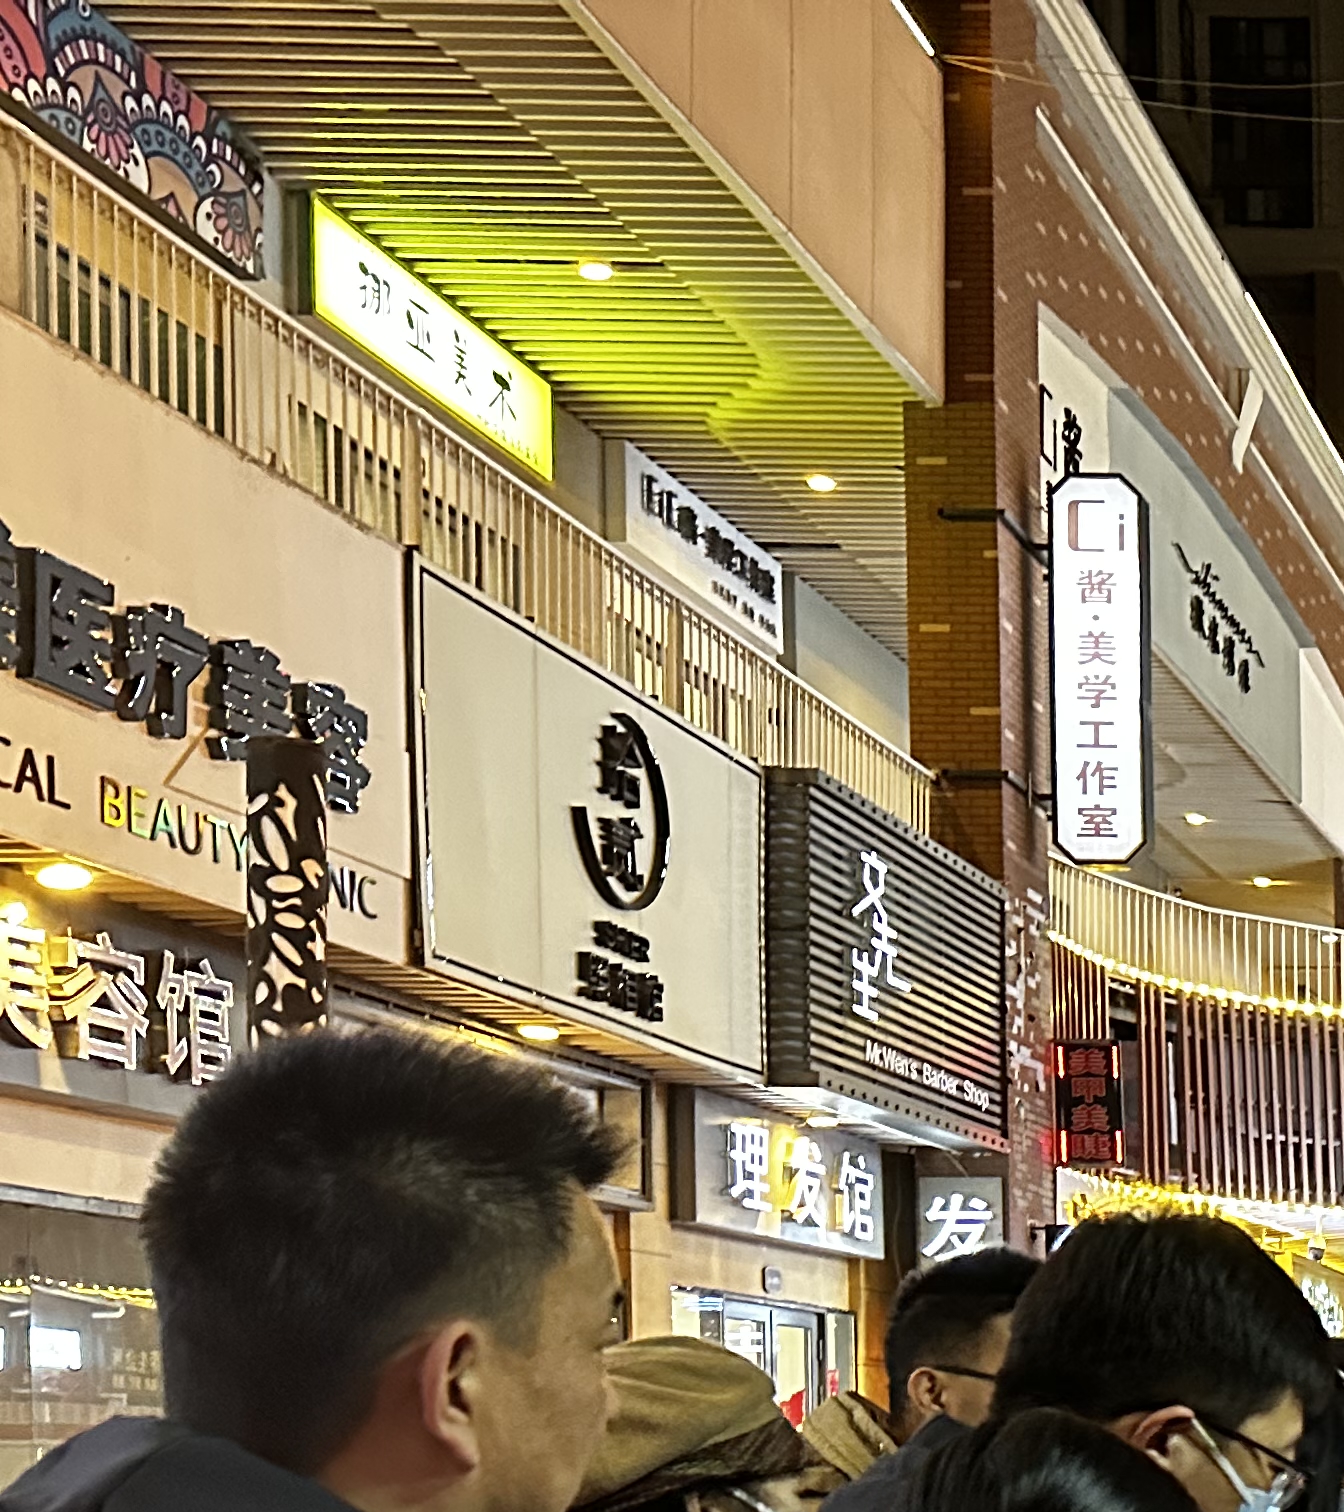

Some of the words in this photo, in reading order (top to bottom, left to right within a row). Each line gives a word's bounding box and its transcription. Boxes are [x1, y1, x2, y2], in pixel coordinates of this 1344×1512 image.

[0, 520, 371, 813] 医疗美容
[327, 862, 378, 919] NIC
[922, 1063, 960, 1098] Barber
[963, 1079, 990, 1112] Shop
[728, 1121, 874, 1242] 理发馆
